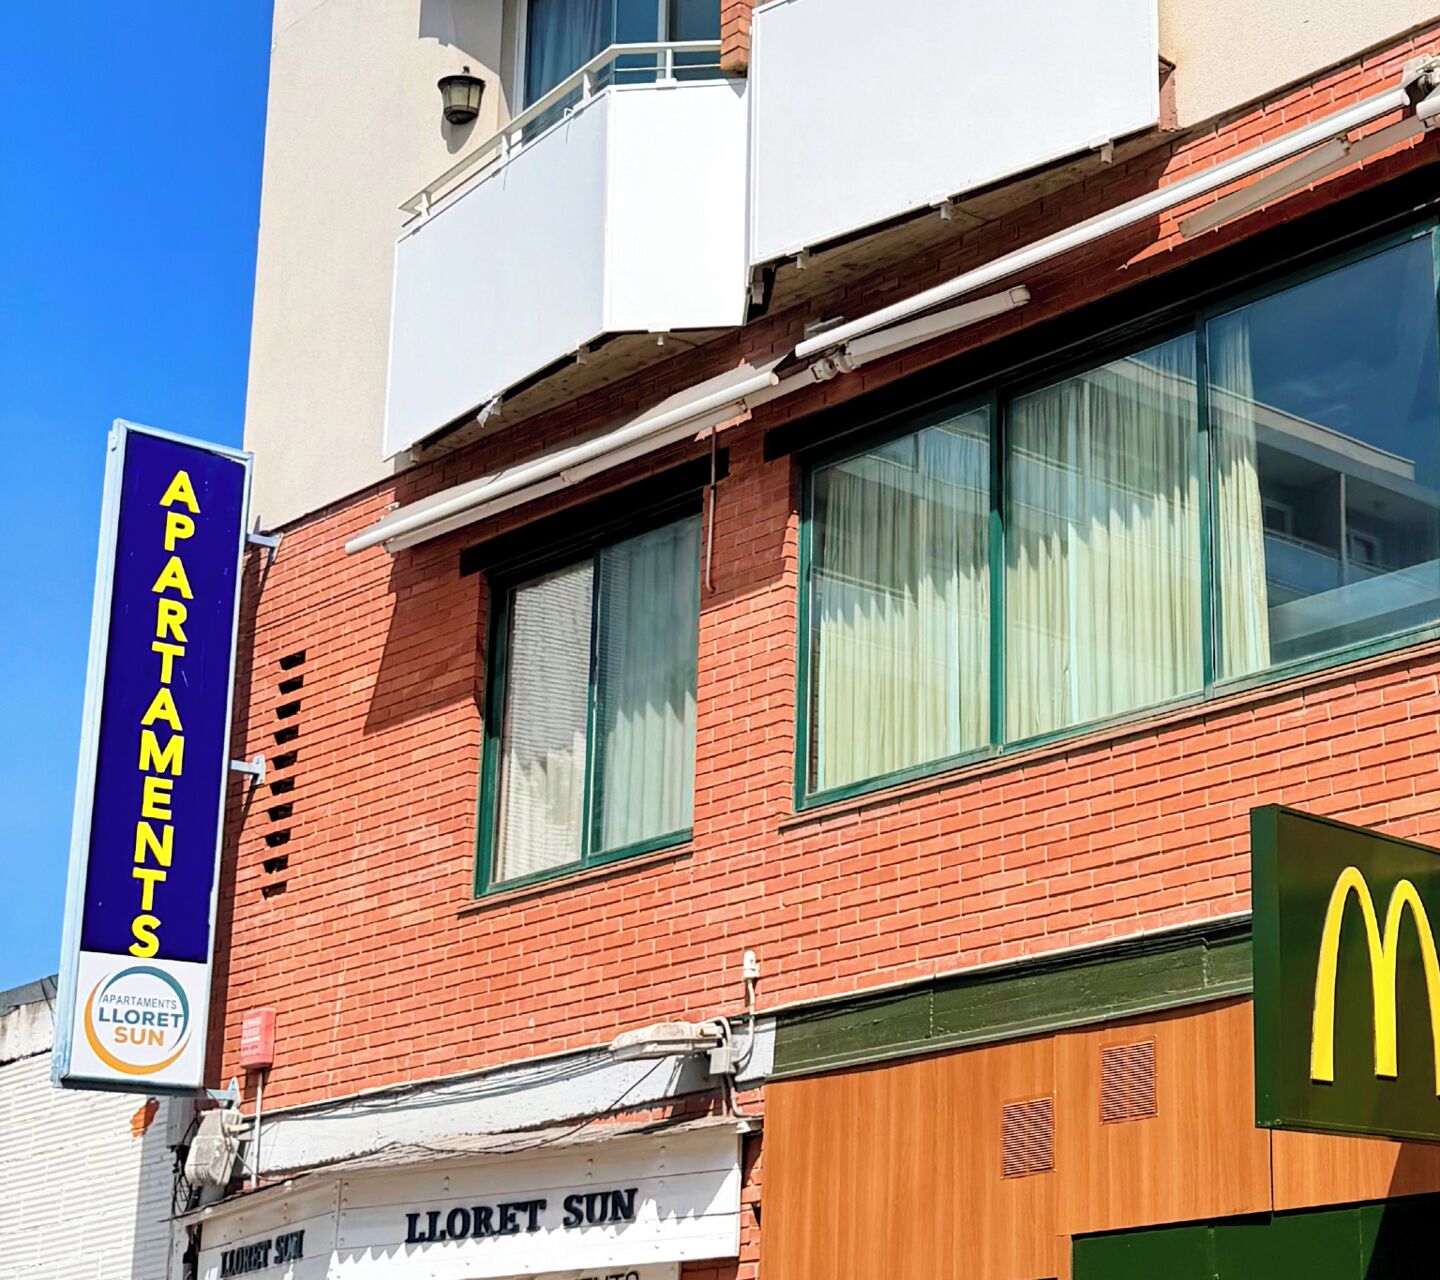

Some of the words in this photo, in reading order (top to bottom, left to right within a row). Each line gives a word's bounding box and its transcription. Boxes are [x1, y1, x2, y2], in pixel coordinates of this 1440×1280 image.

[129, 469, 201, 959] APARTAMENTS
[98, 1007, 183, 1028] LLORET
[102, 994, 177, 1010] APARTAMENTS
[114, 1026, 165, 1046] SUN
[405, 1199, 547, 1245] LLORET
[562, 1187, 639, 1228] SUN
[219, 1238, 272, 1279] LLORET
